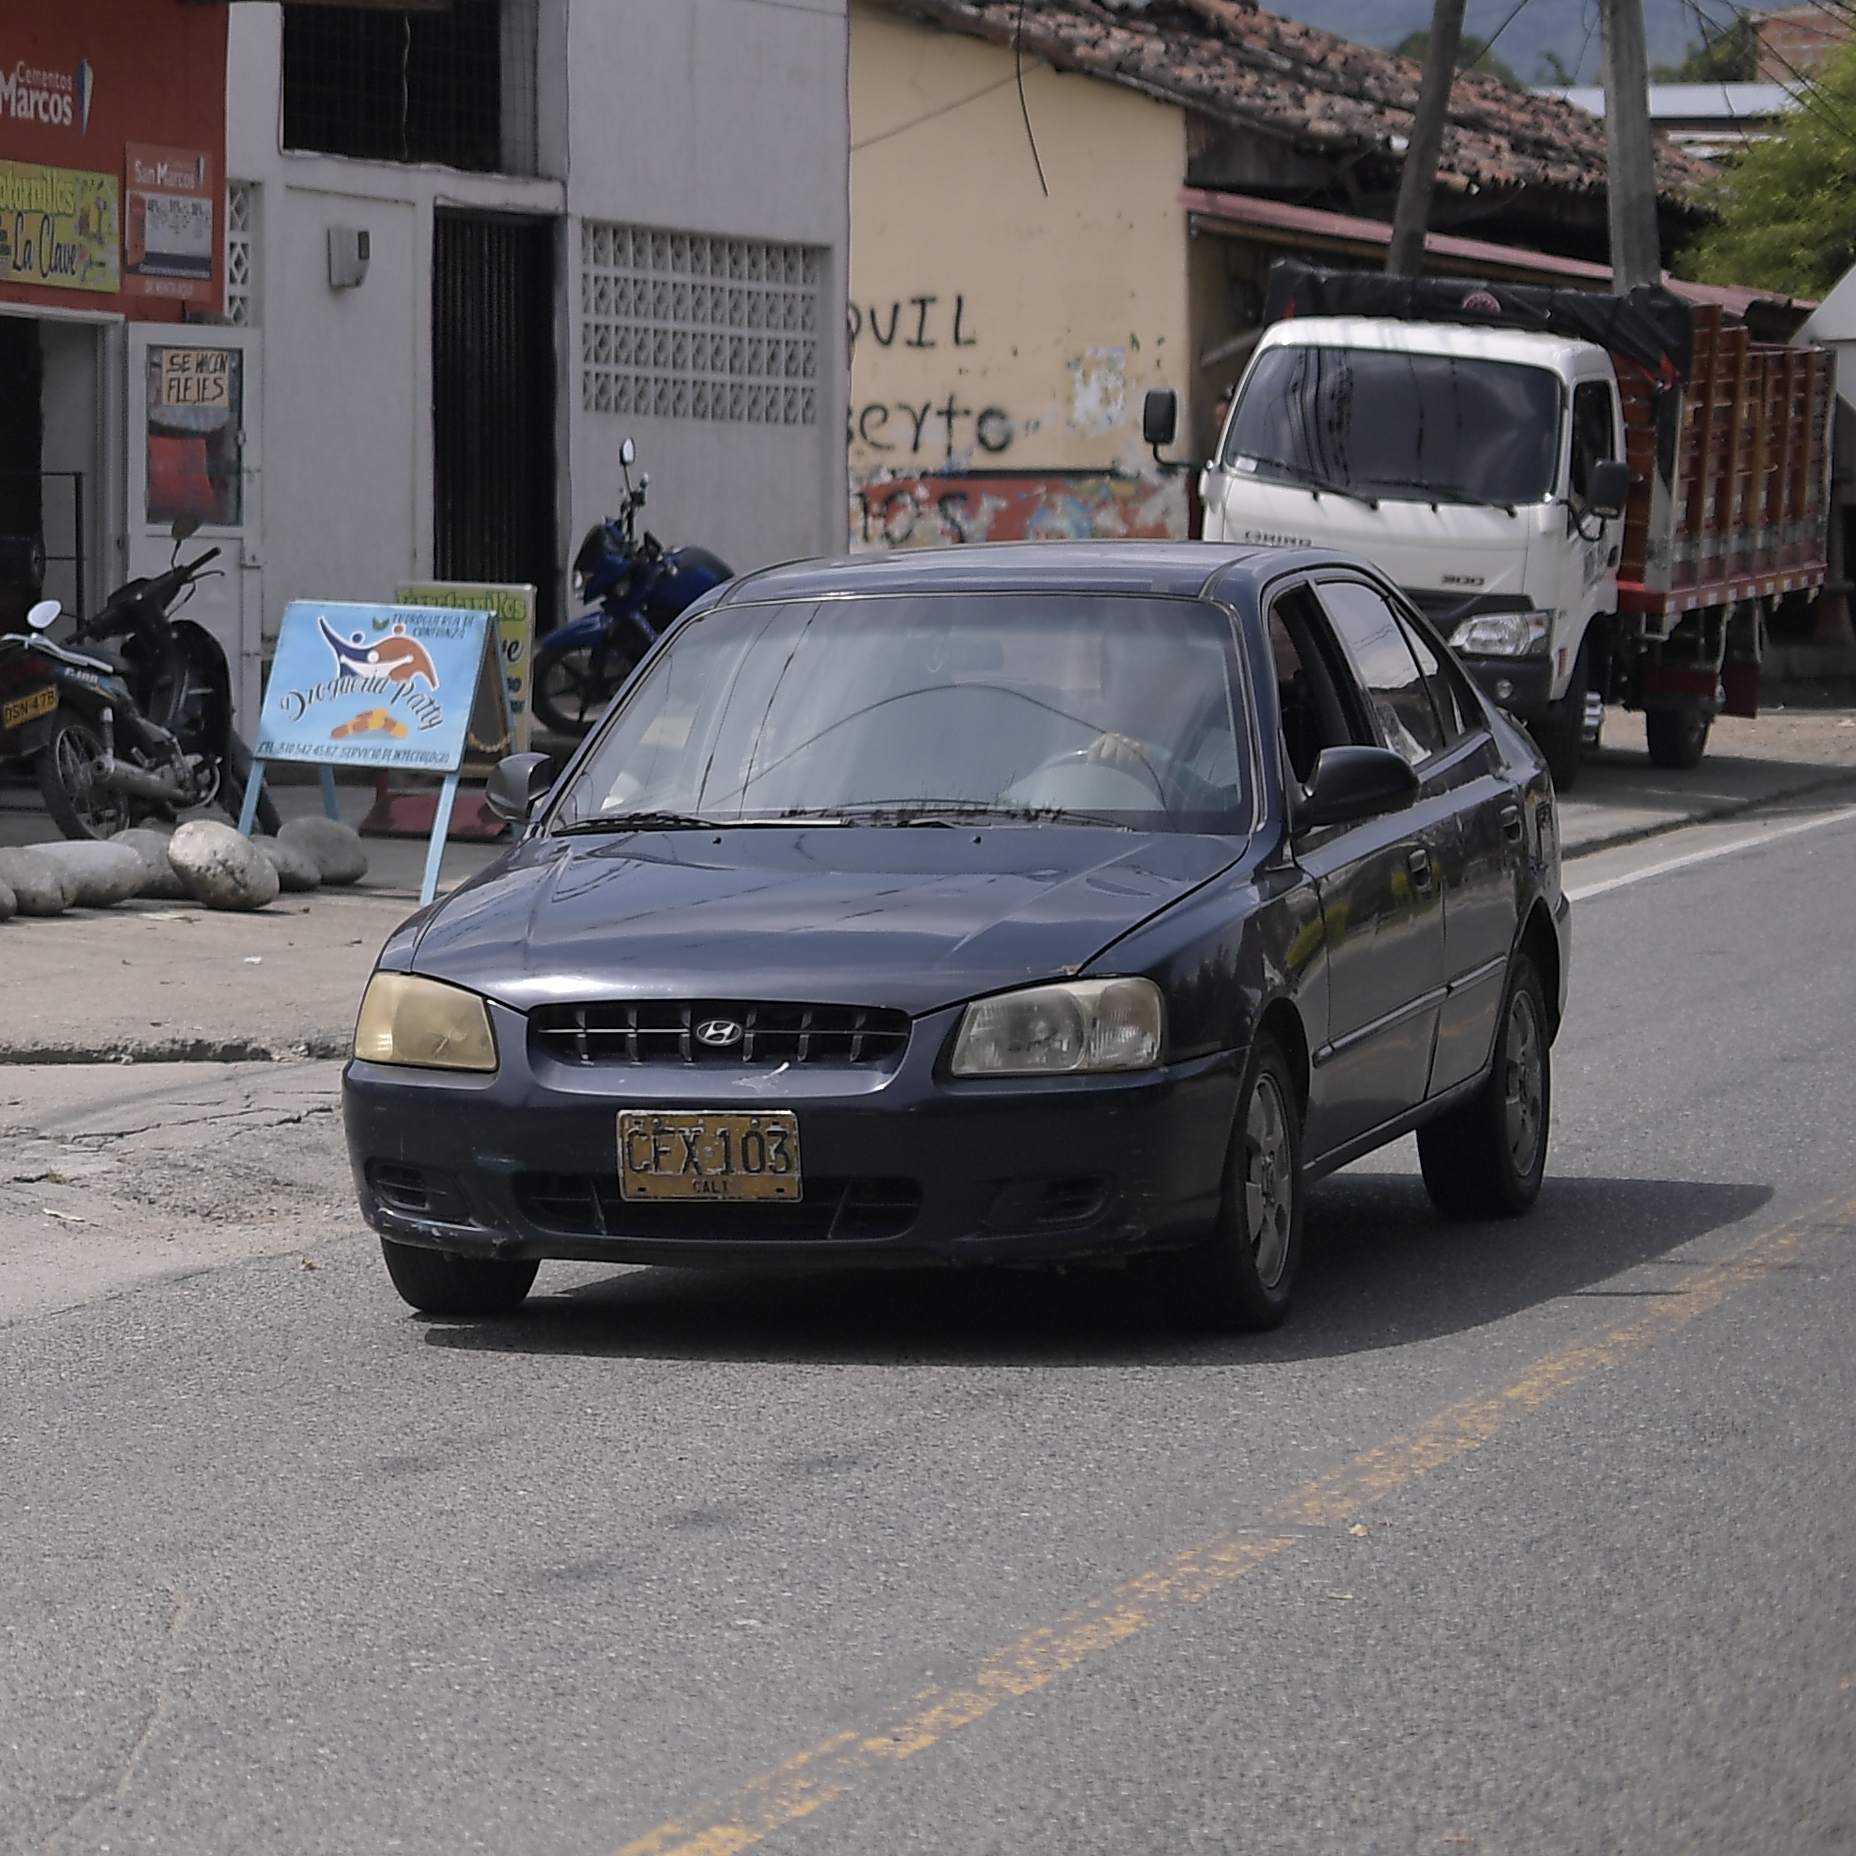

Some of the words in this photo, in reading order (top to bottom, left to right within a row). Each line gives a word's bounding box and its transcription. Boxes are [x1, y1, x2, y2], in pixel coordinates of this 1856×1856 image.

[16, 60, 73, 92] Cementos
[12, 211, 34, 273] La
[39, 213, 79, 279] Clave
[709, 1126, 793, 1175] 103
